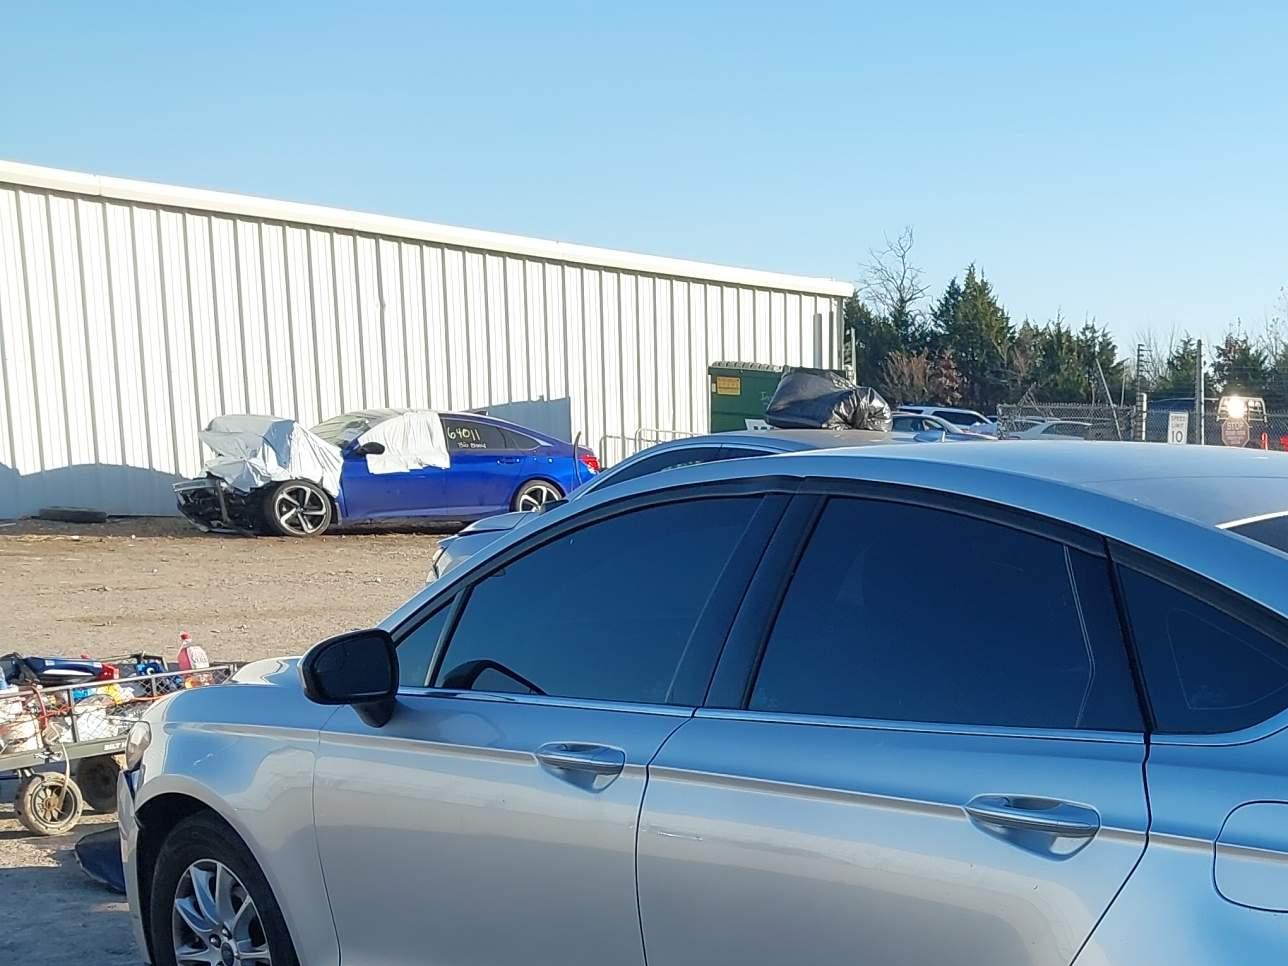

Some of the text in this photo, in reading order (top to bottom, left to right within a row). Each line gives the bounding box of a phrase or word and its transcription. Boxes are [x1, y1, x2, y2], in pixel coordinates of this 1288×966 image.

[1227, 422, 1244, 431] STOP
[447, 426, 481, 441] 64011
[1171, 430, 1183, 443] 10
